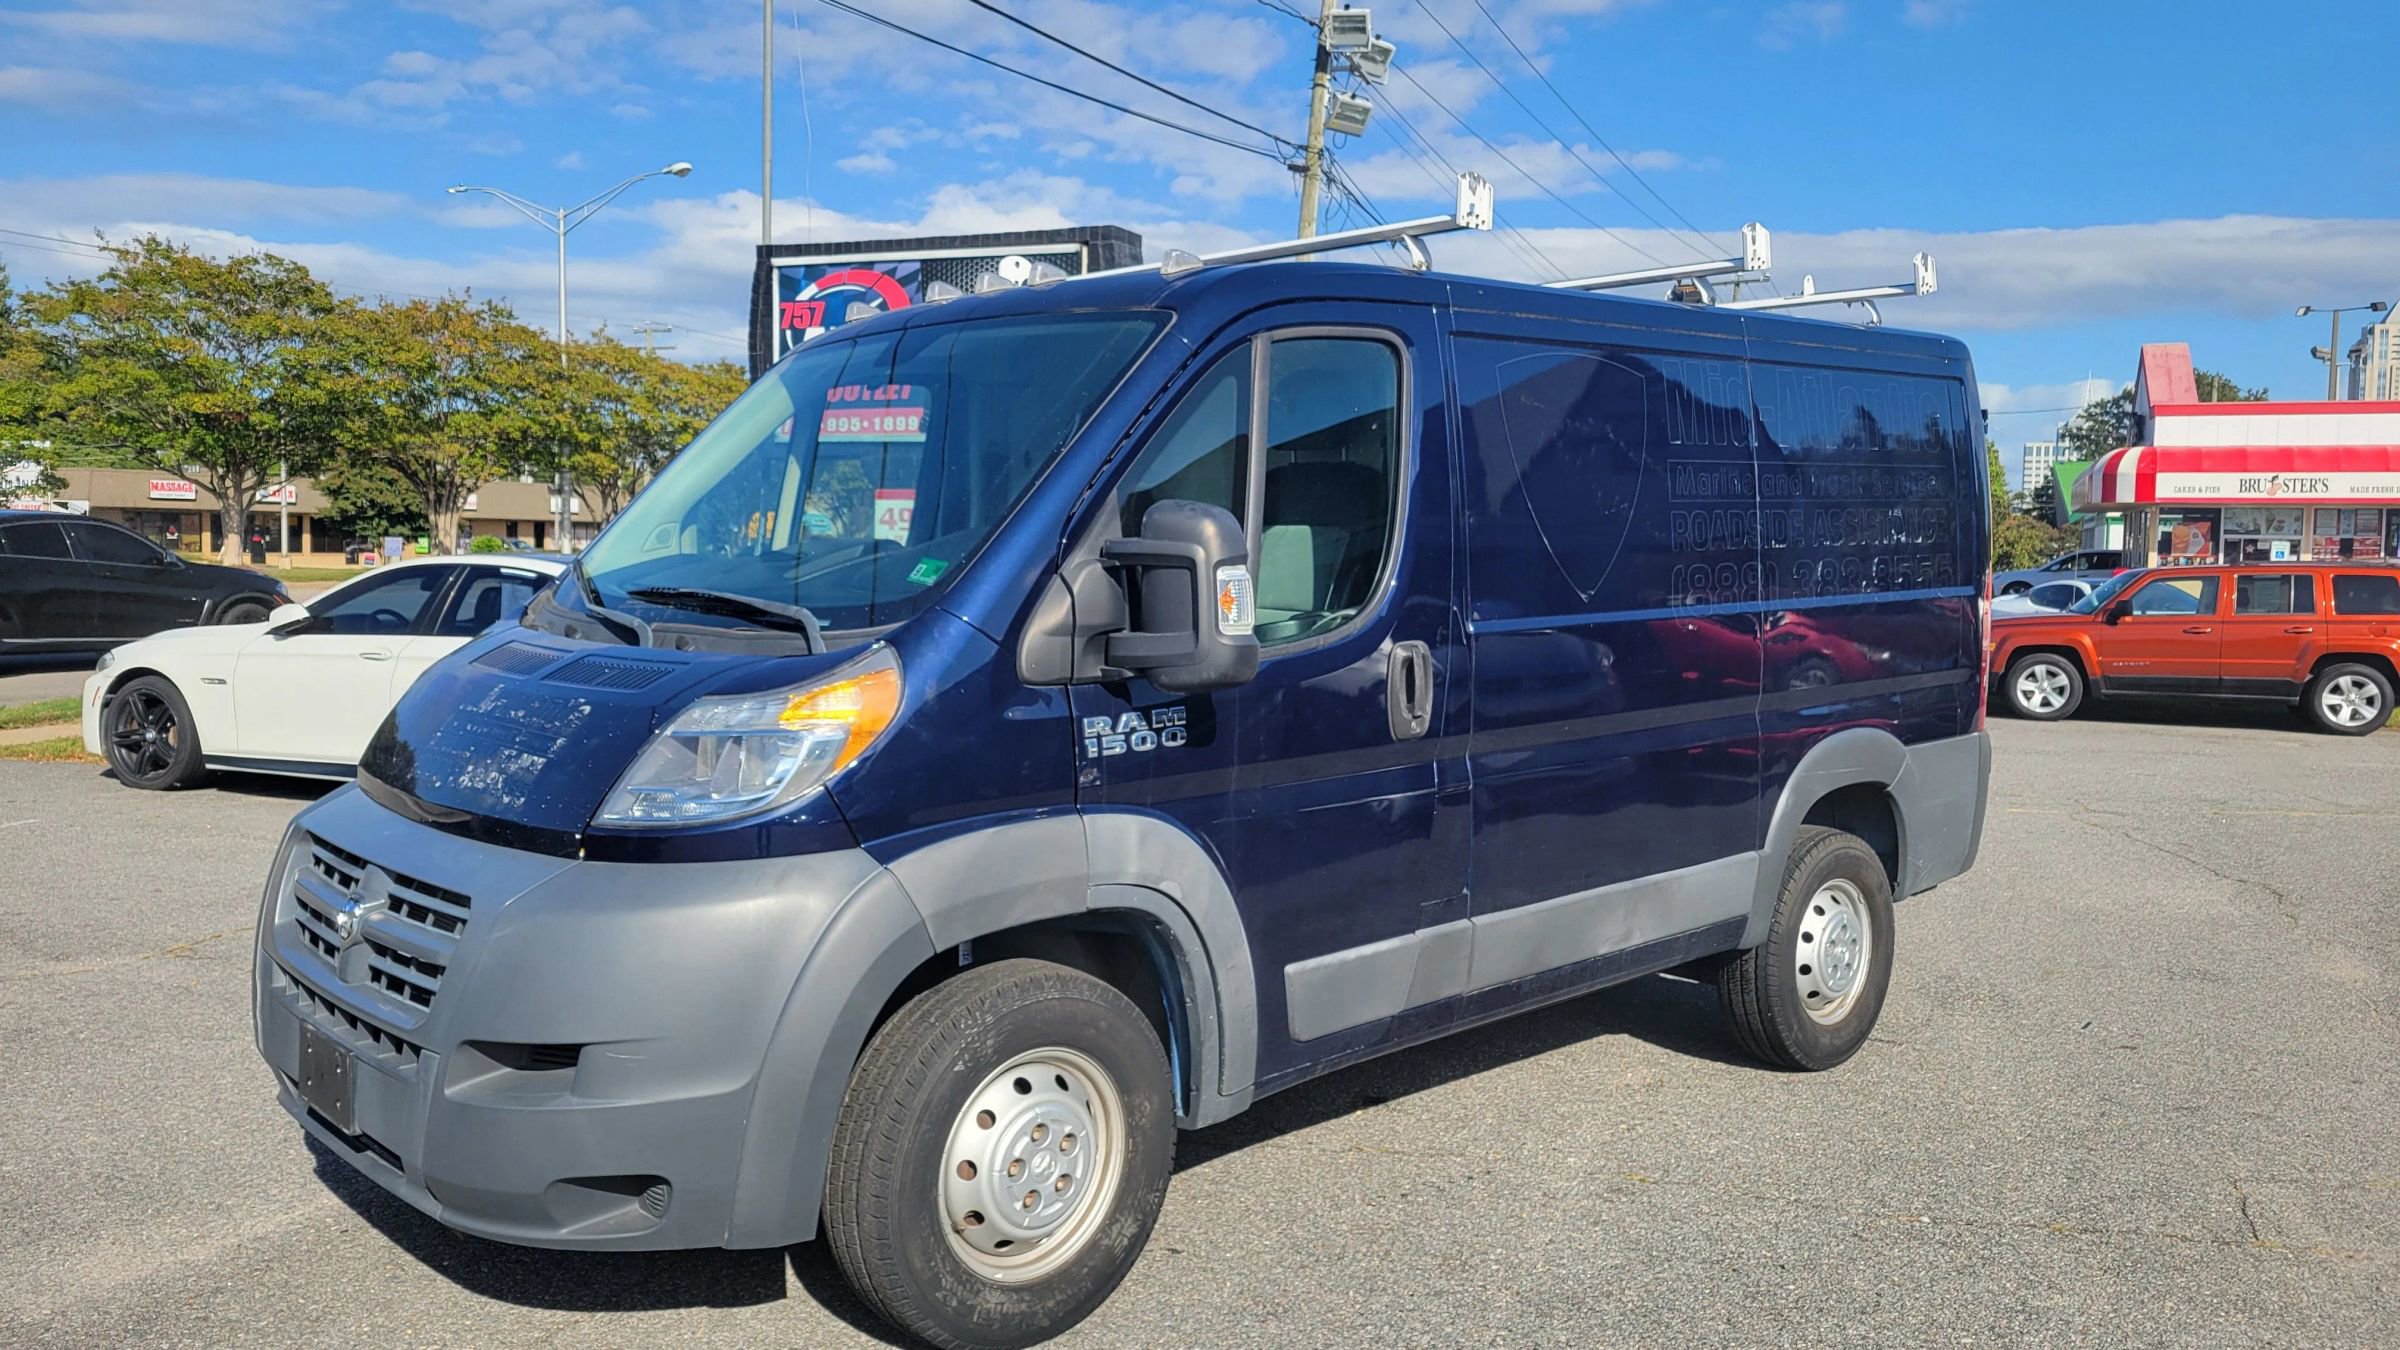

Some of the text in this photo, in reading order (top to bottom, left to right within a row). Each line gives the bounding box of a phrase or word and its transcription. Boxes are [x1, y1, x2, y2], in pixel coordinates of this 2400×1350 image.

[779, 301, 825, 330] 757
[150, 481, 193, 493] MASSAGE
[1675, 465, 1755, 496] Marine
[1761, 466, 1802, 496] and
[2173, 486, 2196, 494] CAKES
[2205, 486, 2221, 494] PIES
[2350, 485, 2370, 494] MADE
[2371, 485, 2394, 494] FRESH
[1670, 509, 1805, 552] ROADSIDE
[1811, 507, 1948, 547] ASSISTANCE
[1082, 706, 1187, 738] RAM
[1084, 726, 1187, 758] 1500
